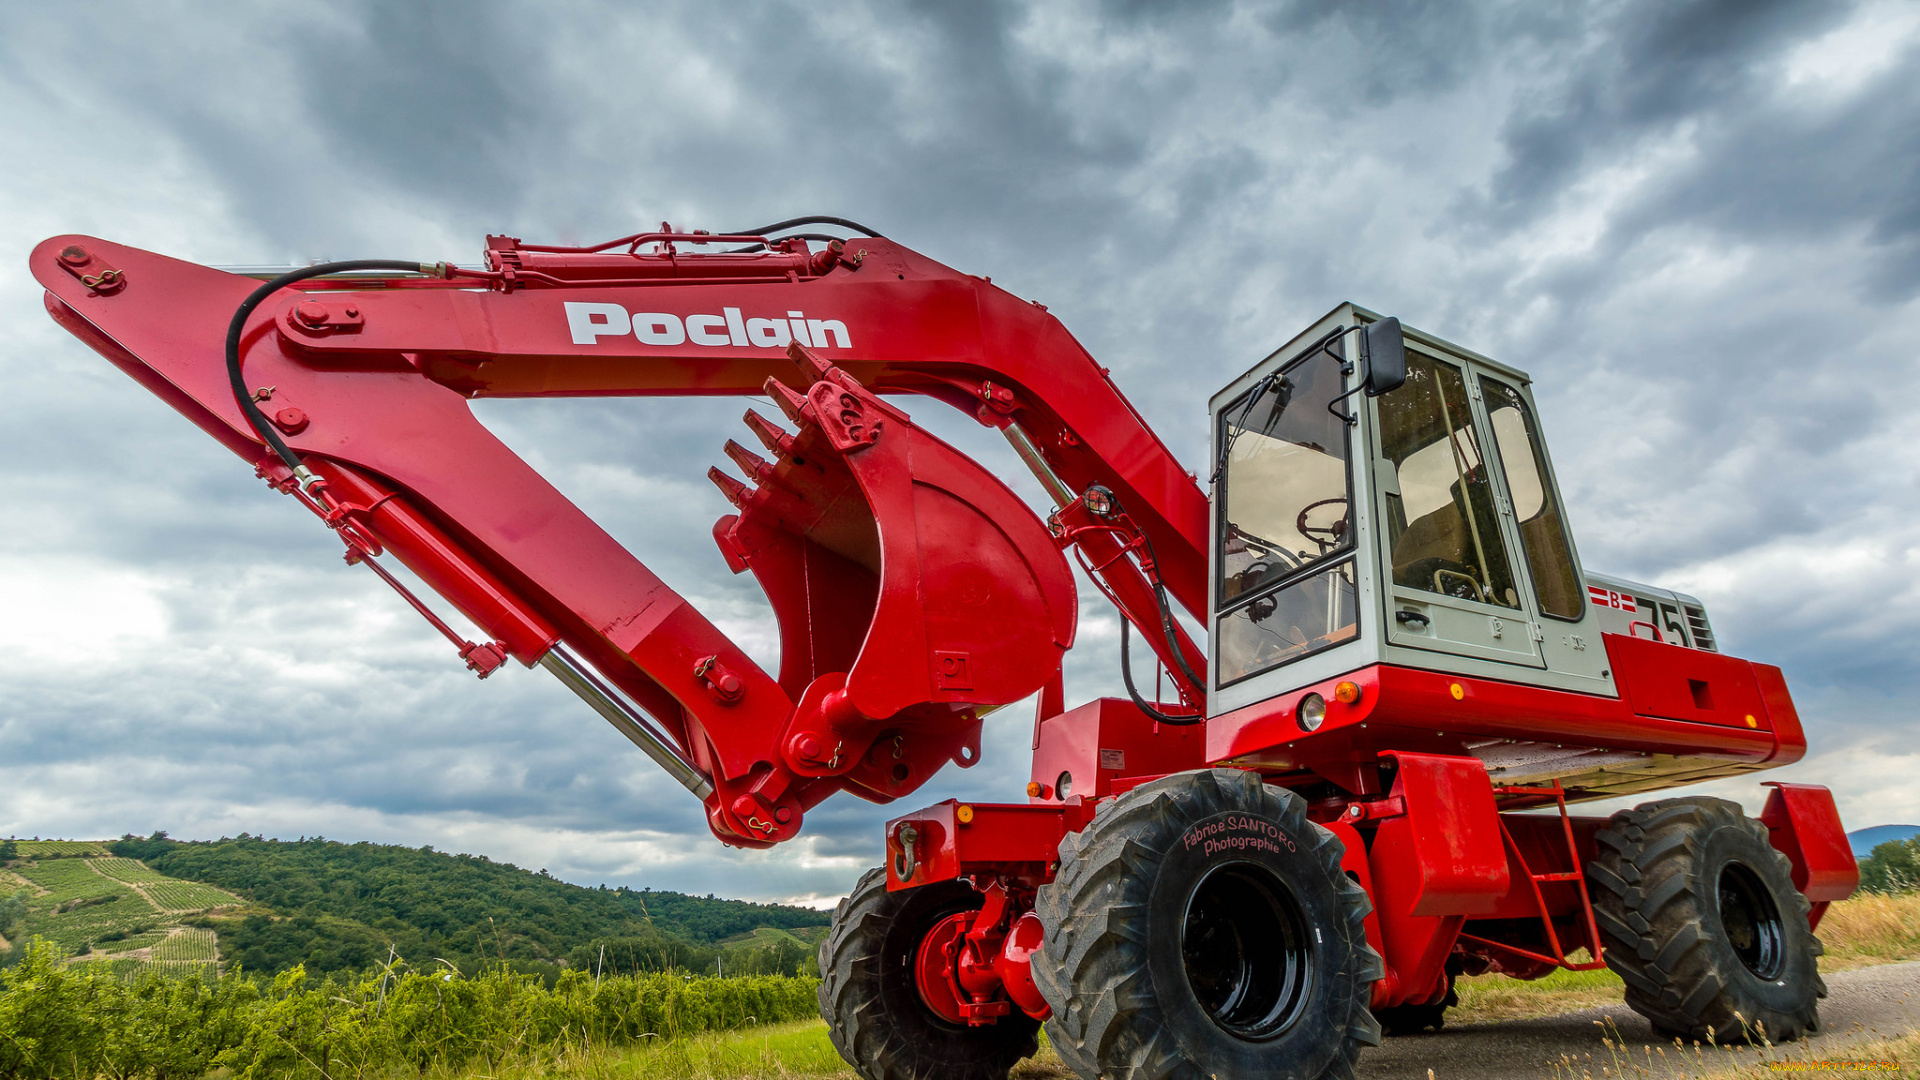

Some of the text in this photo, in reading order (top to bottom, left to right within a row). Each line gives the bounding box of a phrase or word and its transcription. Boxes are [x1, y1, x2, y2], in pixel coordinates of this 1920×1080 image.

[563, 301, 852, 348] Poclain
[1609, 590, 1690, 648] B 75
